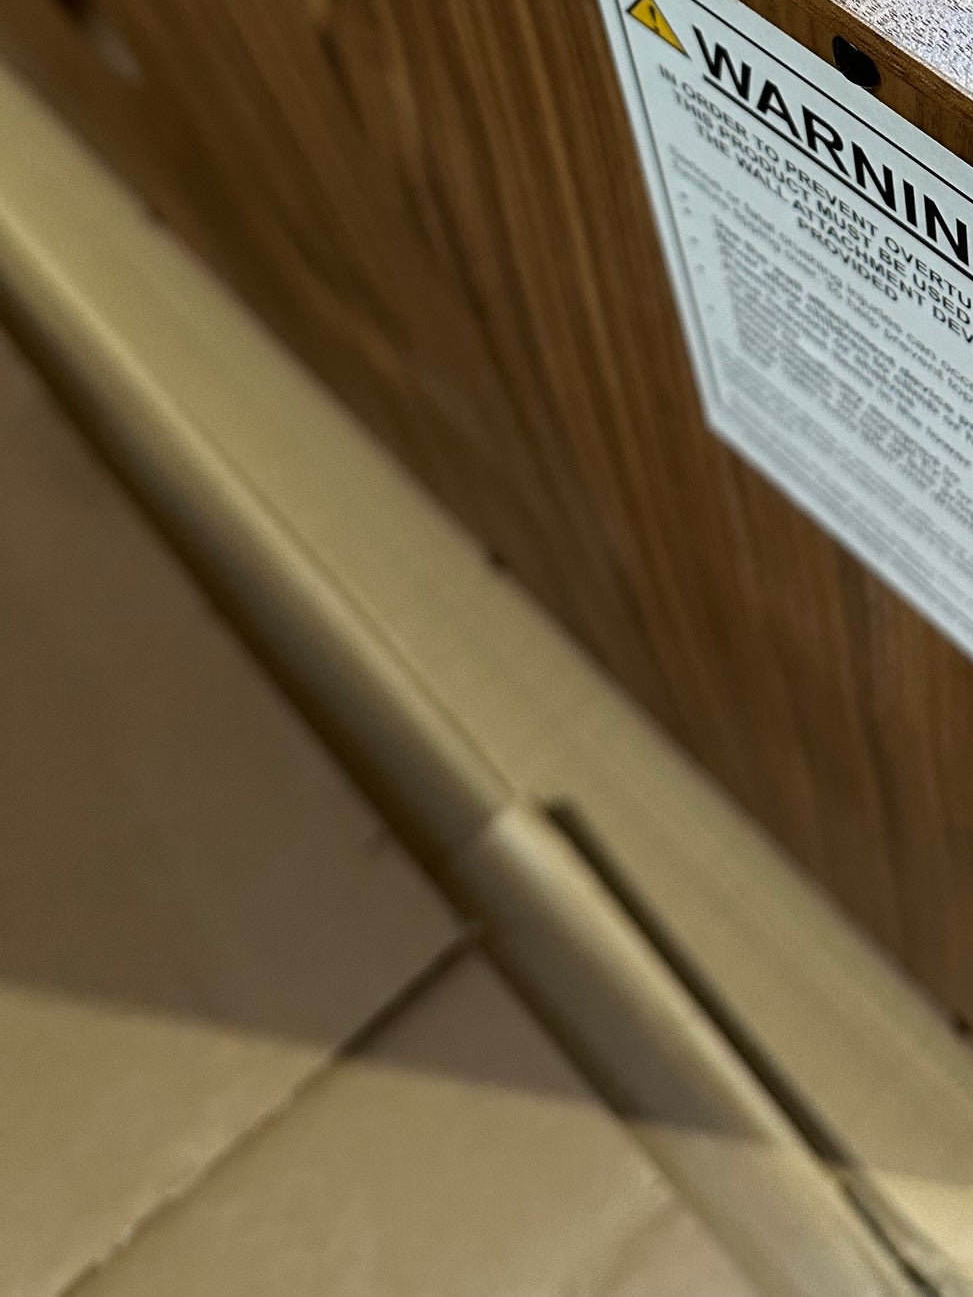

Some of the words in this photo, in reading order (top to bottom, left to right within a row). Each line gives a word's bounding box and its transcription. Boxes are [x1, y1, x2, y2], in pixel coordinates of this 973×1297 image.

[658, 64, 677, 86] IN
[681, 80, 747, 139] ORDER
[754, 135, 779, 163] TO
[784, 158, 877, 238] PREVENT
[674, 92, 713, 129] THIS
[719, 125, 811, 204] PRODUCT
[817, 200, 872, 251] MUST
[878, 247, 906, 276] BE
[913, 273, 969, 326] USED
[696, 123, 729, 157] THE
[736, 154, 786, 200] WALL
[792, 196, 925, 308] ATTACHMENT
[797, 216, 897, 302] PROVIDED
